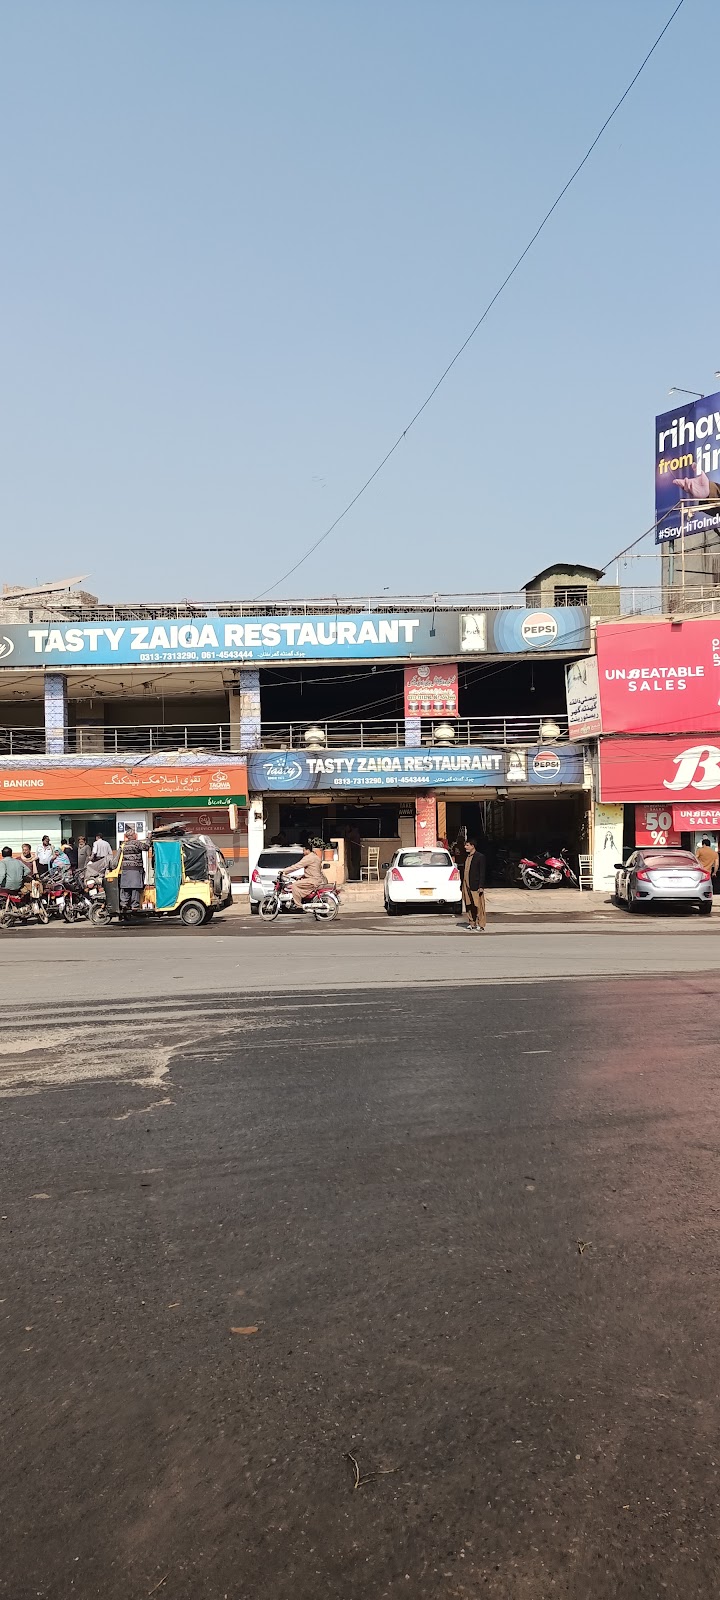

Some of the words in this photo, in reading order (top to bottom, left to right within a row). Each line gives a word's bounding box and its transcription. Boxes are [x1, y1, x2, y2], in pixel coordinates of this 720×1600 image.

[659, 453, 693, 475] from
[659, 513, 720, 539] #SayHiToInd
[28, 628, 125, 653] TASTY
[131, 624, 219, 651] ZAIQA
[224, 619, 420, 647] RESTAURANT
[524, 625, 556, 635] PEPSI
[712, 638, 720, 652] TO
[140, 651, 199, 662] 0313-7313290,
[201, 650, 253, 660] 061-4543444
[713, 652, 720, 667] UP
[605, 666, 705, 680] UNBEATABLE
[628, 680, 687, 692] SALES
[263, 763, 296, 778] Tasty
[306, 758, 355, 774] TASTY
[357, 757, 404, 773] ZAIQA
[404, 754, 503, 772] RESTAURANT
[534, 761, 559, 769] PEPSI
[3, 779, 44, 788] BANKING
[646, 812, 672, 831] 50
[651, 831, 666, 845] %
